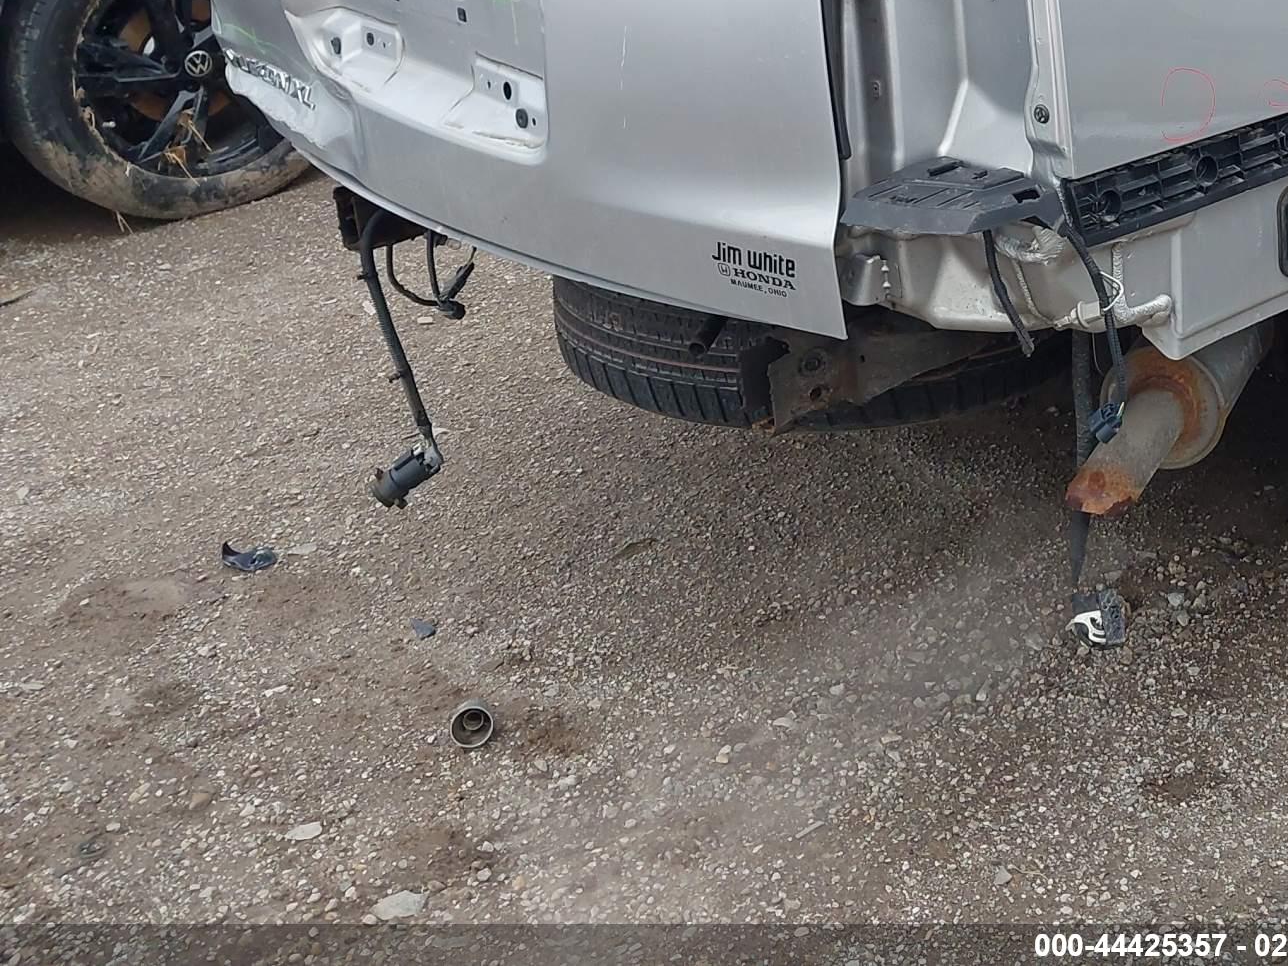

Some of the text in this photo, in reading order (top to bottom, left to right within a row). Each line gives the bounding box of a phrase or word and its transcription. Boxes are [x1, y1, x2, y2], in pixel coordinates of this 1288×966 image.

[711, 241, 743, 266] Jim
[732, 267, 797, 291] HONDA
[767, 287, 788, 298] OHIO
